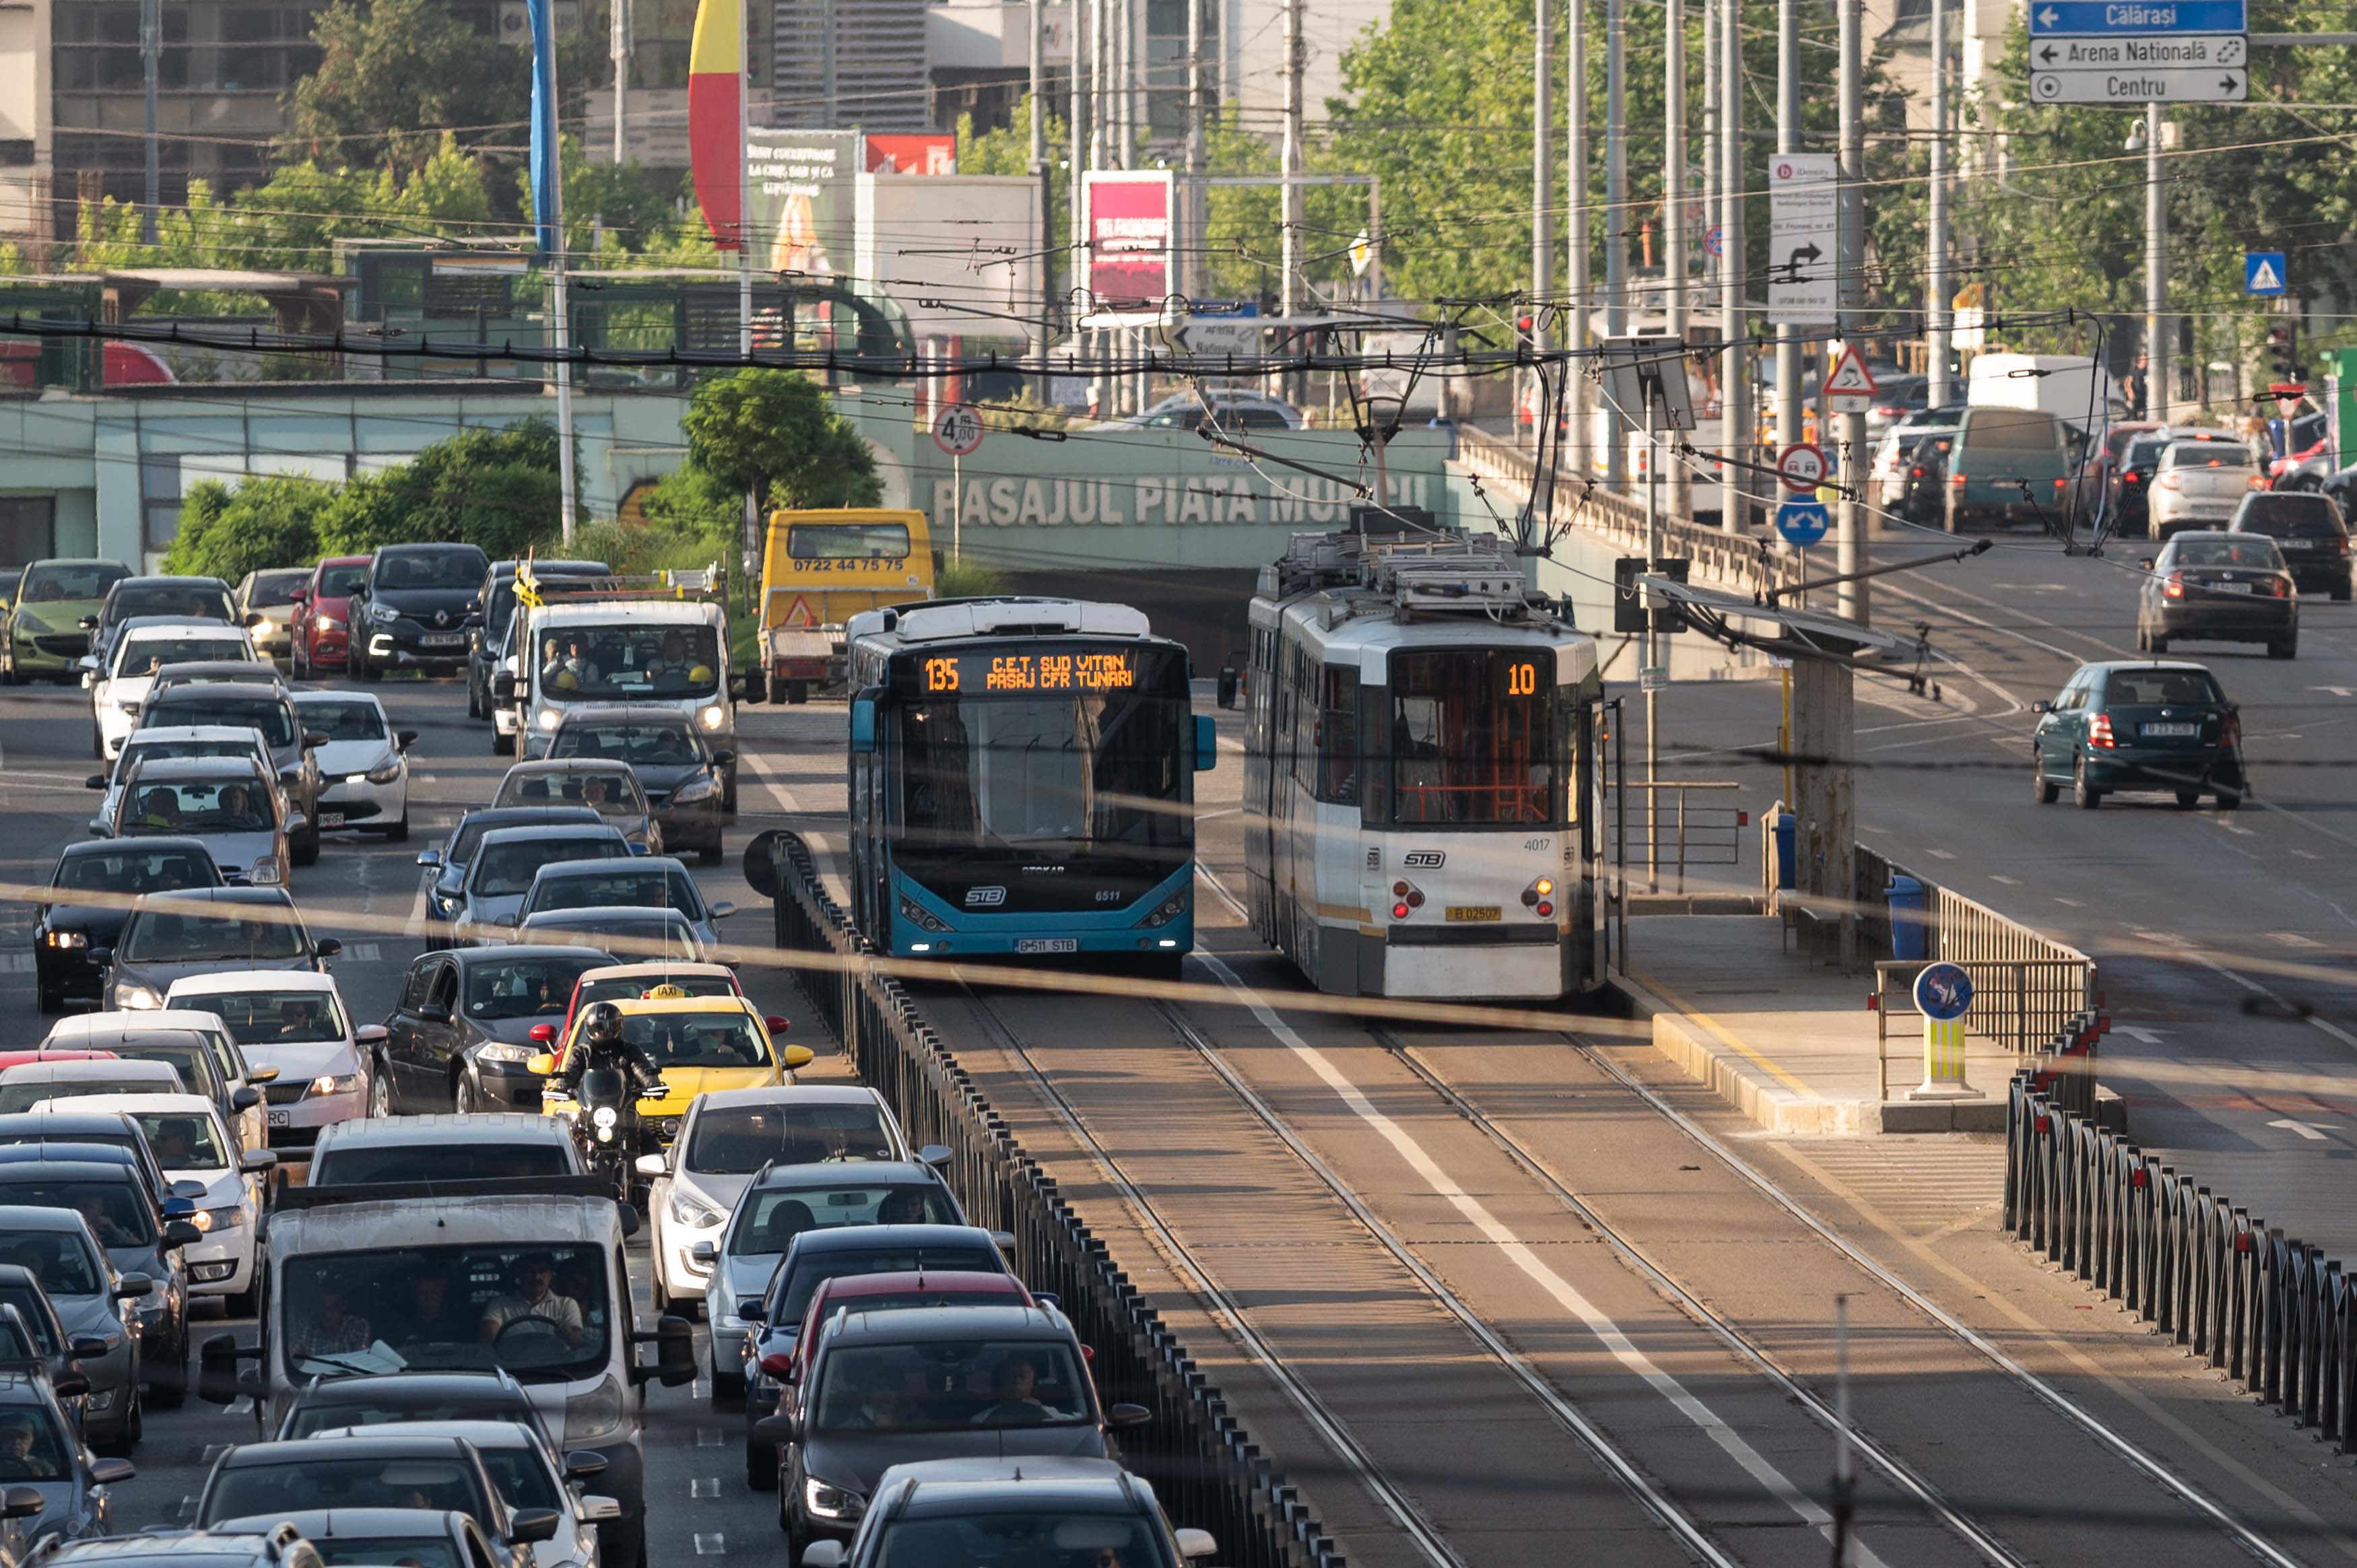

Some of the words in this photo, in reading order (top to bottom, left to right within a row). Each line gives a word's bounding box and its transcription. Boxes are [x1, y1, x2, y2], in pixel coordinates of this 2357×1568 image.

[2106, 4, 2177, 27] Călărași
[2068, 43, 2119, 61] Arena
[2127, 41, 2206, 63] Națională
[2107, 75, 2165, 96] Centru
[933, 477, 1123, 526] PASAJUL
[1136, 476, 1256, 524] PIATA
[794, 560, 831, 571] 0722
[836, 560, 855, 570] 44
[862, 559, 879, 570] 75
[885, 559, 903, 570] 75
[1040, 656, 1071, 671] SUD
[1075, 654, 1125, 671] VITAN
[925, 658, 959, 690] 135
[987, 673, 1035, 689] PASAJ
[1040, 672, 1071, 688] CFR
[1075, 670, 1133, 687] TUNARI
[1508, 664, 1535, 695] 10
[1525, 839, 1550, 851] 4017
[1404, 851, 1445, 868] STB
[965, 887, 1005, 905] STB
[1095, 891, 1120, 901] 6511
[1053, 941, 1074, 952] STB
[657, 987, 677, 996] TAXI
